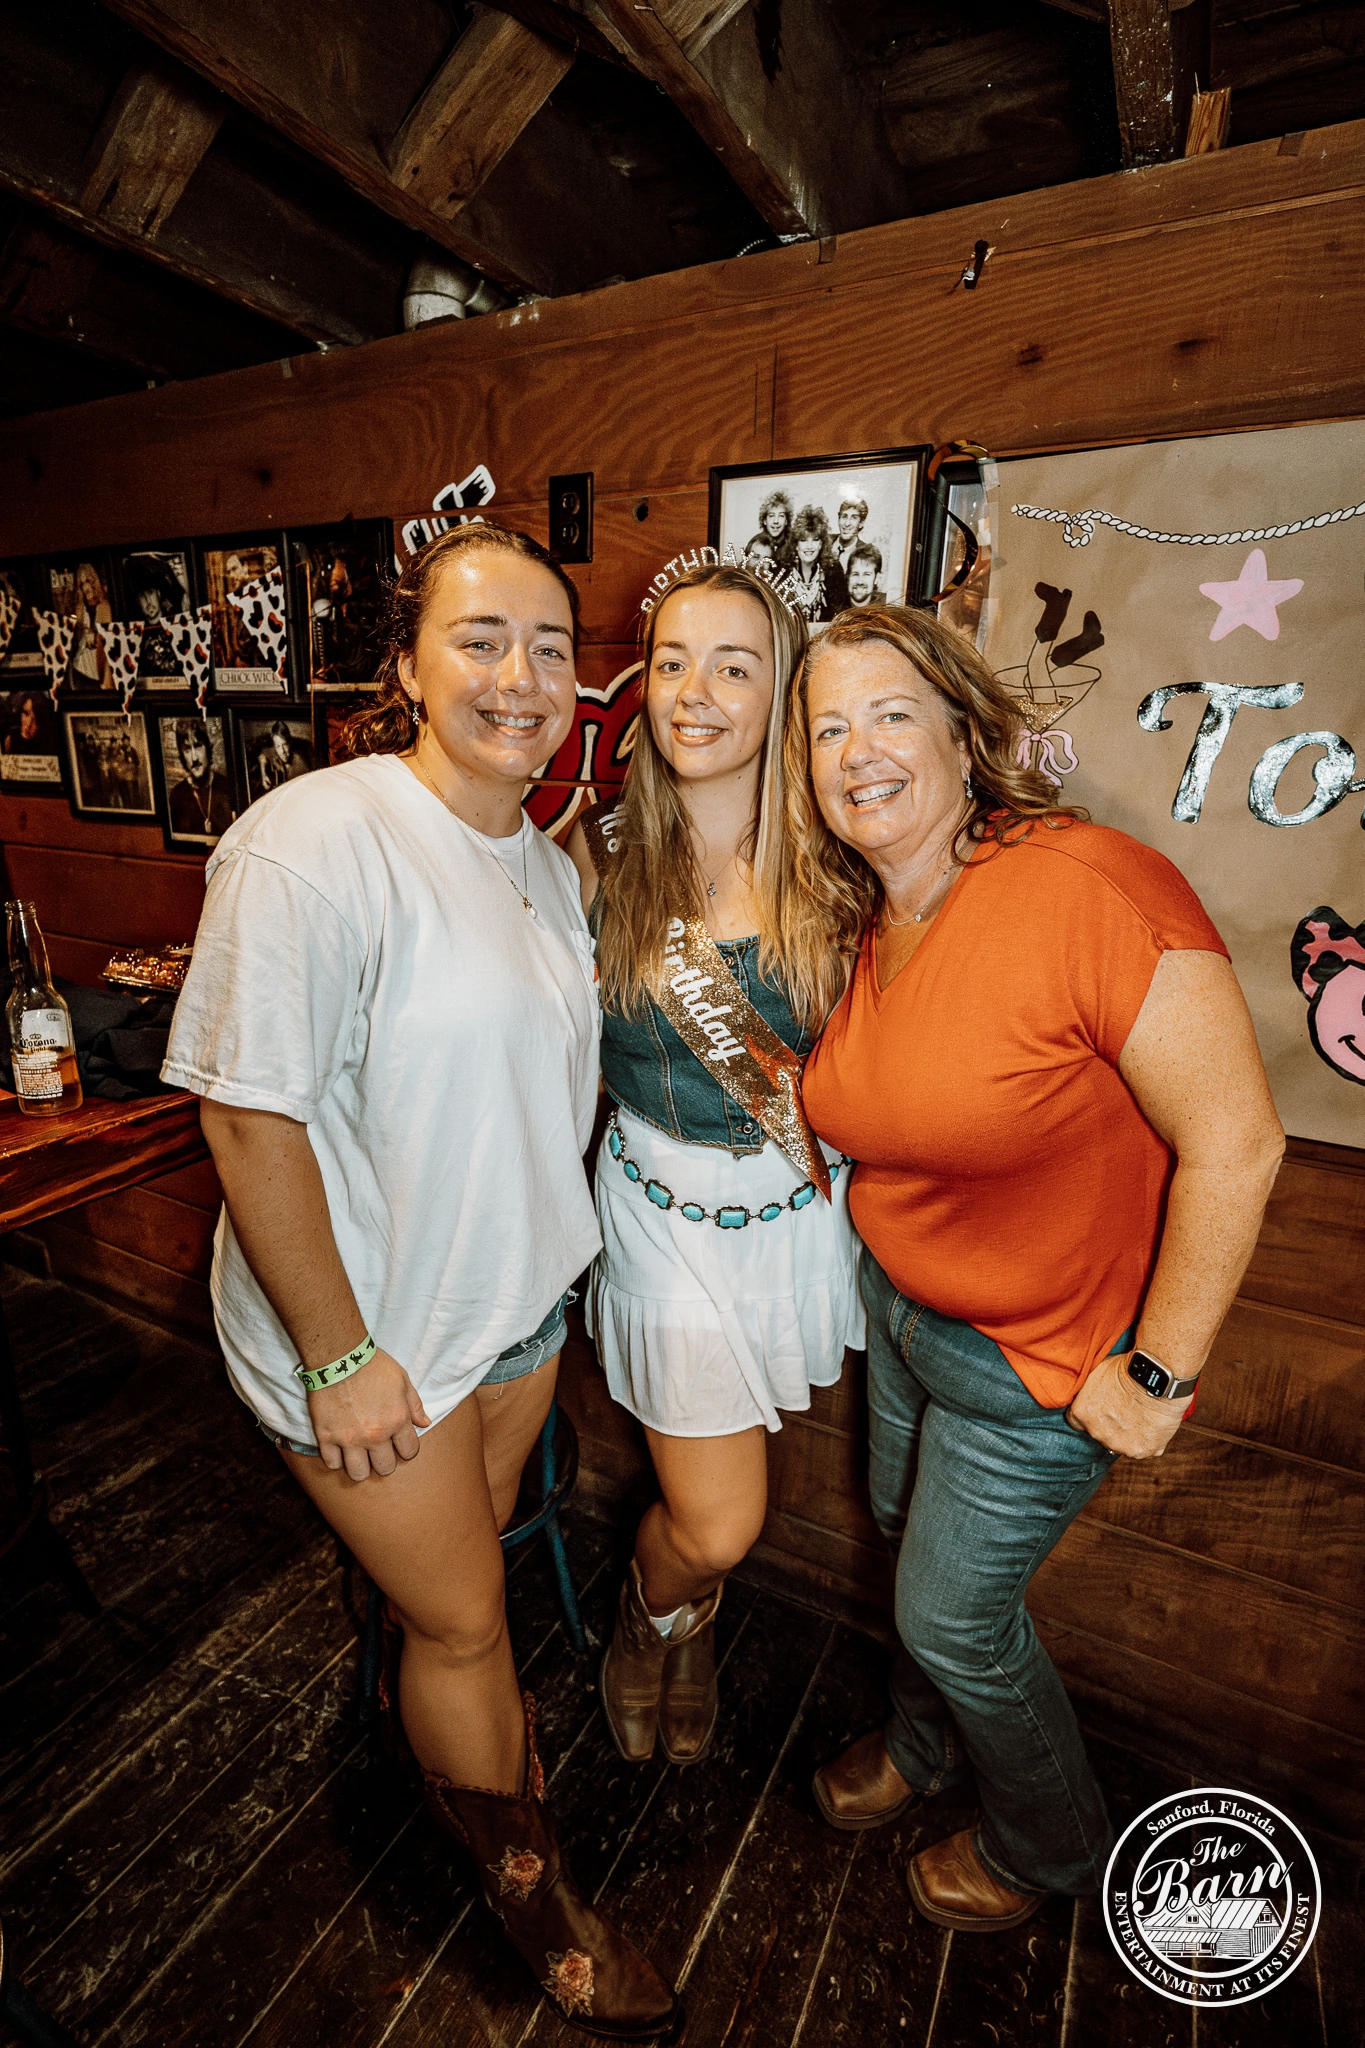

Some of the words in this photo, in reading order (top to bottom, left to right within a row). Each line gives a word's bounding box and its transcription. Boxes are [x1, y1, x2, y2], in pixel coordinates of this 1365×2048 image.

[640, 542, 755, 613] BIRTHDAY
[755, 557, 808, 617] GIRL
[252, 671, 280, 684] WICK
[1137, 681, 1365, 829] To
[20, 1038, 56, 1049] Corona
